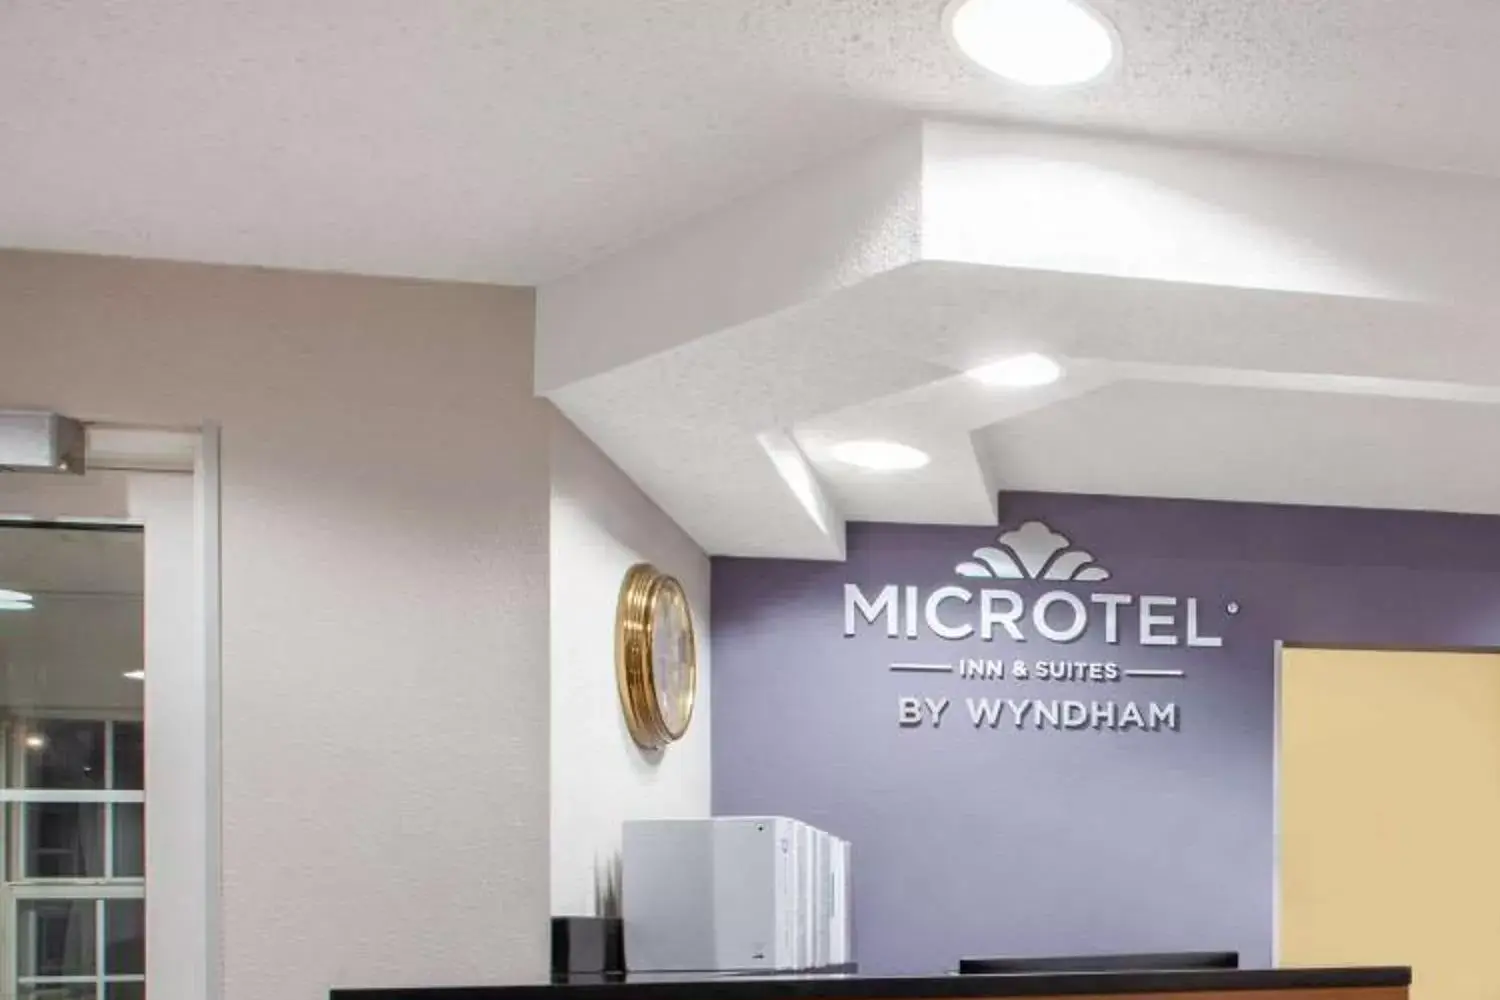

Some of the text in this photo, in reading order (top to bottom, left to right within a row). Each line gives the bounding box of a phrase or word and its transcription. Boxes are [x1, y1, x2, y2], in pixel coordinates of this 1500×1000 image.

[843, 583, 1223, 647] MICROTEL
[959, 659, 1119, 681] INN & SUITES
[899, 697, 1178, 730] BY WYNDHAM
